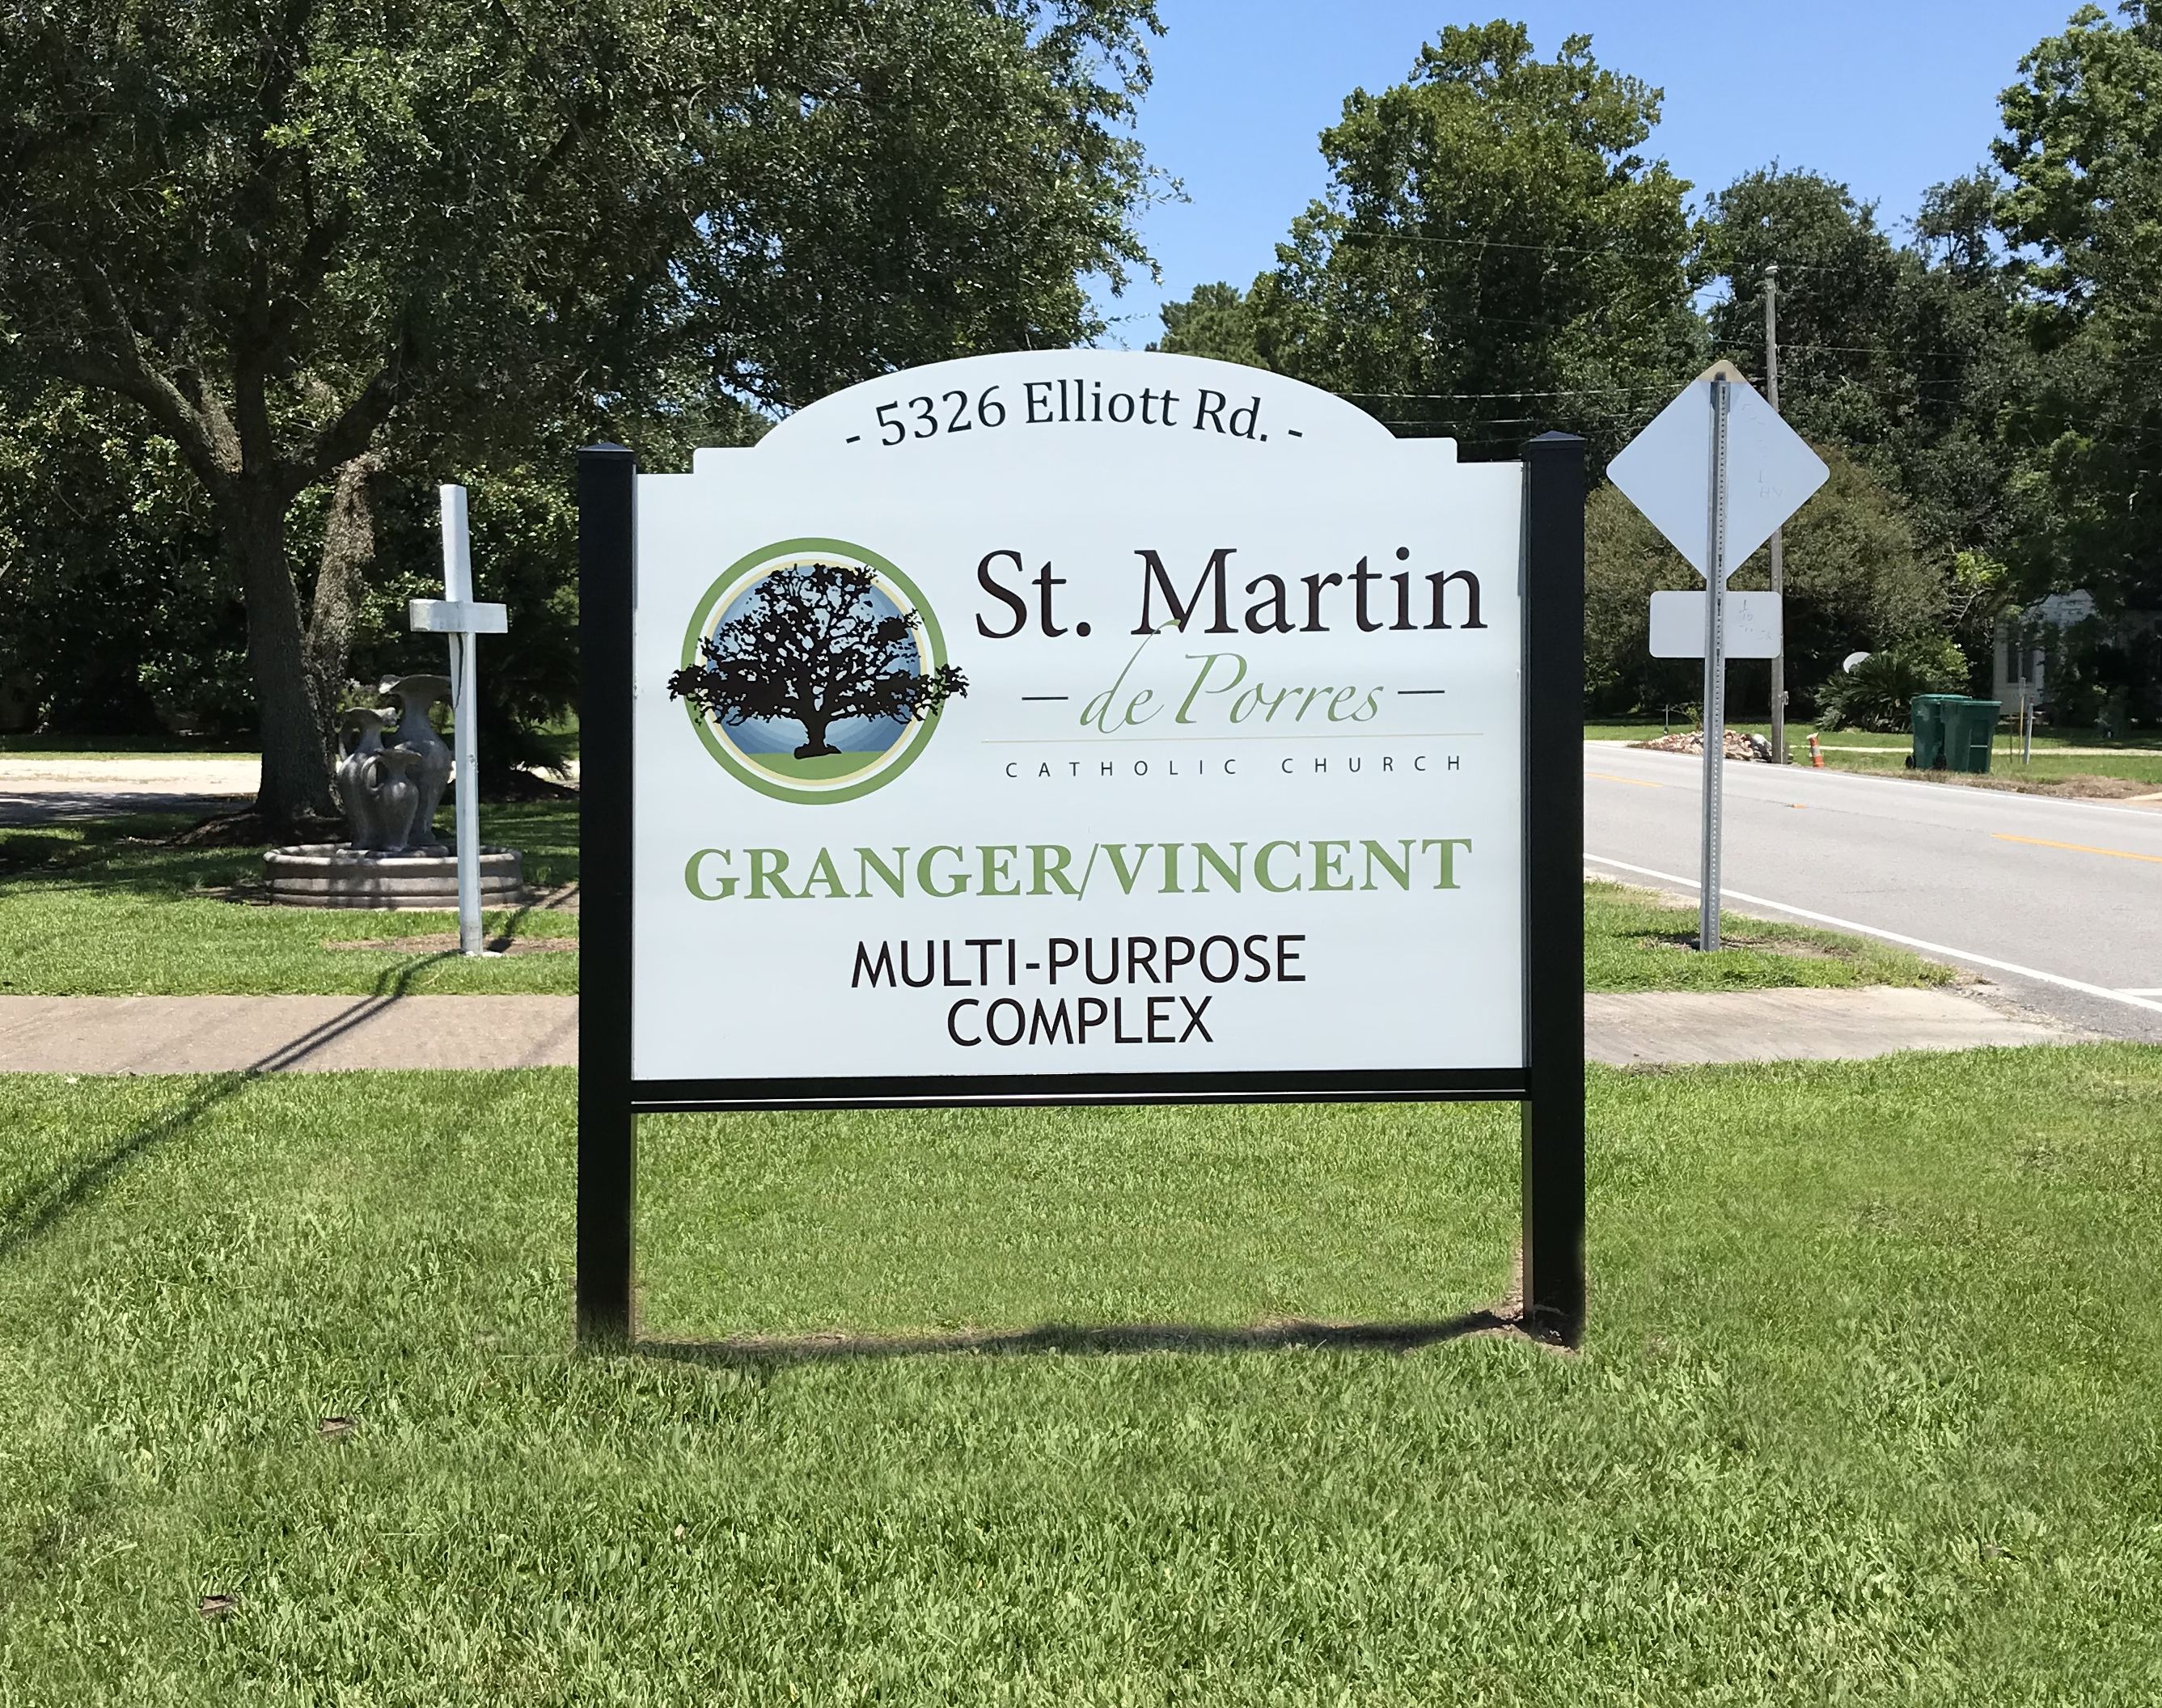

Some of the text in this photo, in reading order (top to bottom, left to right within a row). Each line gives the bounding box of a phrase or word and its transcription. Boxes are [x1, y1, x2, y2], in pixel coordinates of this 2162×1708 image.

[875, 378, 1268, 446] 5326 Elliott Rd.
[975, 546, 1488, 639] St. Martin
[1079, 619, 1385, 734] de Porres
[1005, 755, 1461, 778] CATHOLIC CHURCH
[684, 838, 1473, 902] GRANGER/VINCENT
[851, 934, 1306, 989] MULTI-PURPOSE
[947, 995, 1214, 1047] COMPLEX
